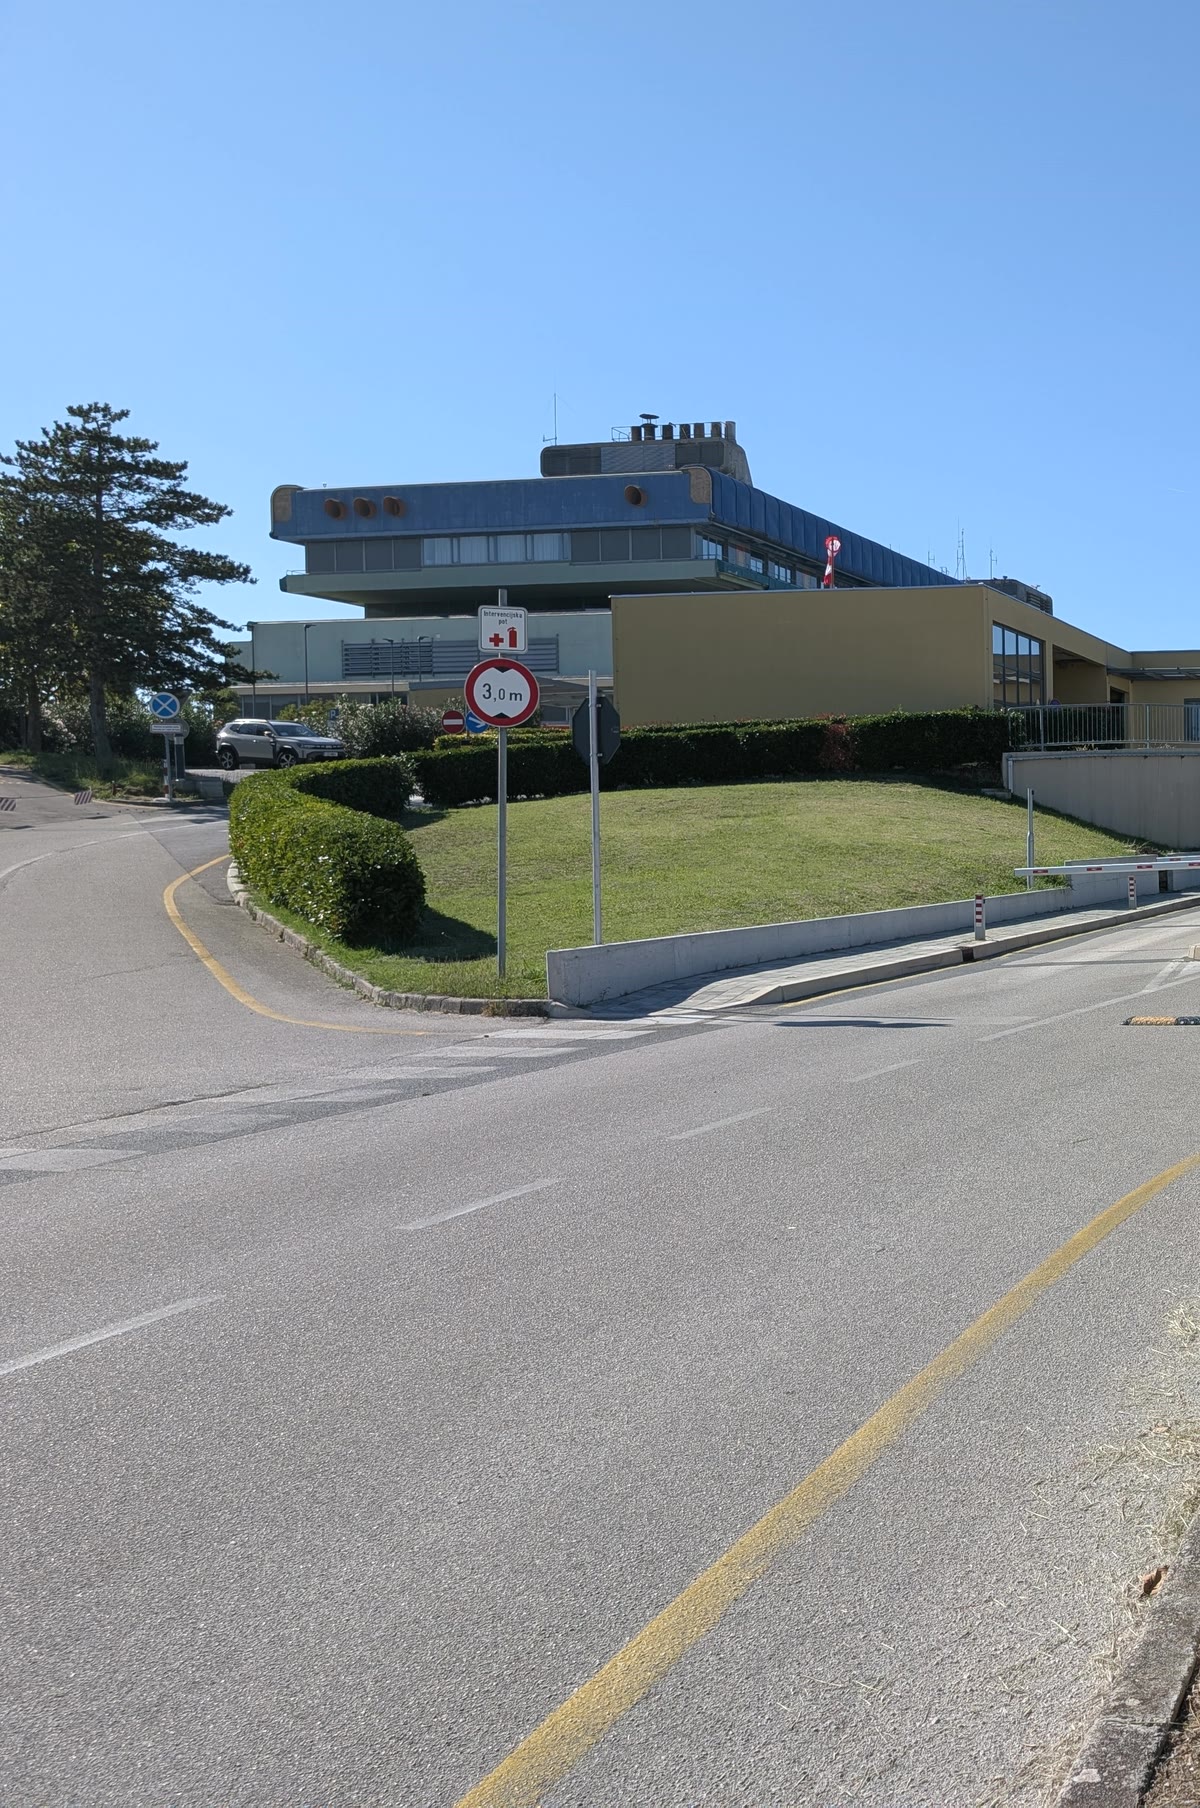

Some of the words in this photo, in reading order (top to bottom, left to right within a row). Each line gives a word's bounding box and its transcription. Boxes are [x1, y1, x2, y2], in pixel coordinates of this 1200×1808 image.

[483, 610, 523, 619] Intervencijska
[482, 683, 506, 702] 3,0
[509, 692, 523, 702] m
[330, 709, 337, 719] P
